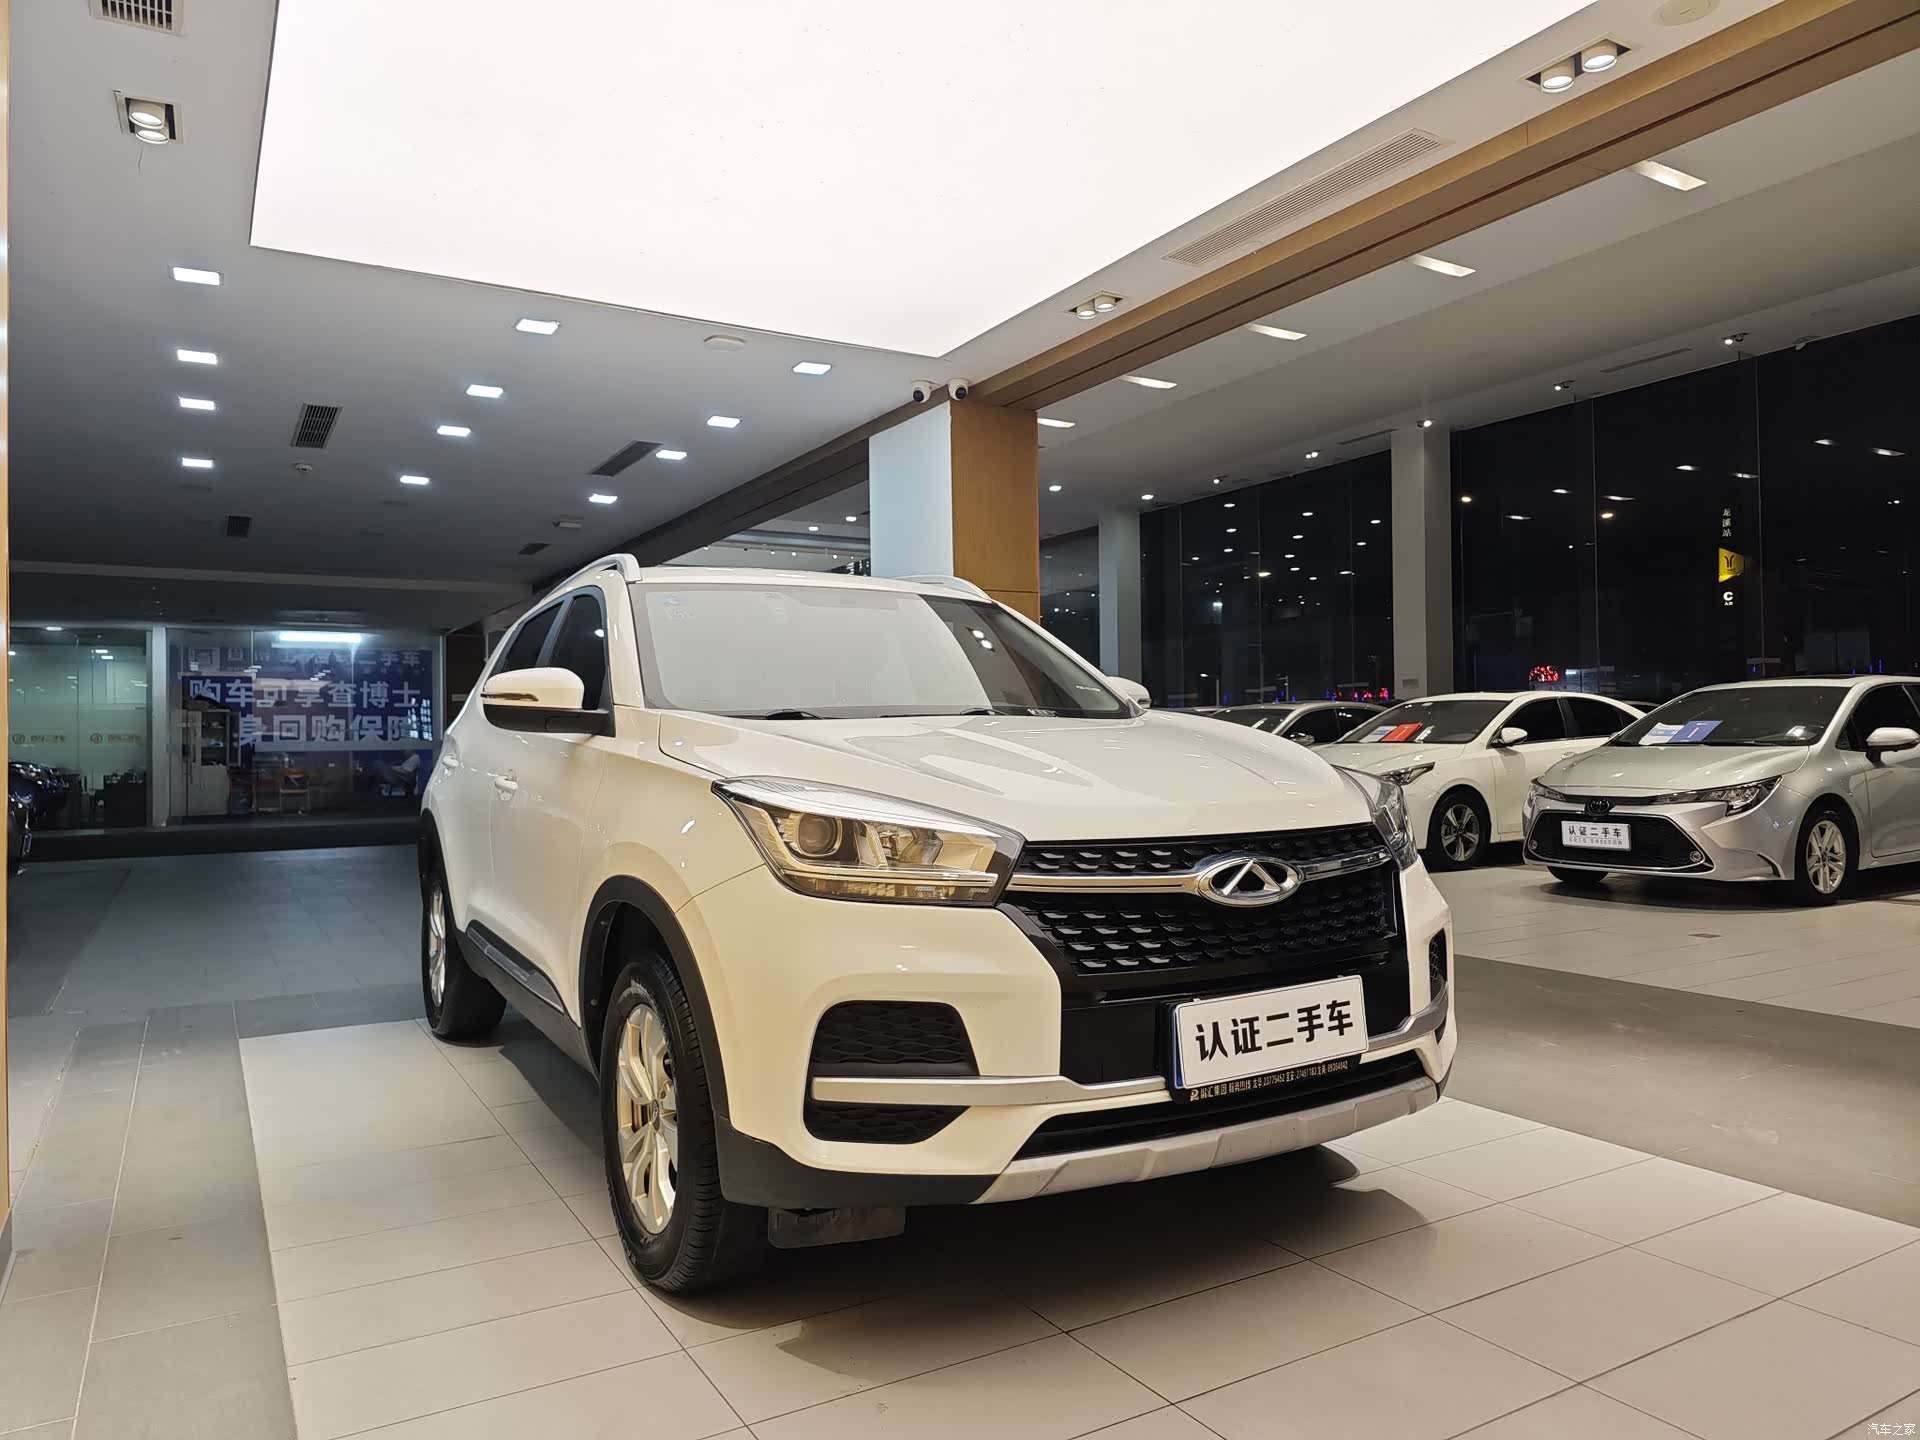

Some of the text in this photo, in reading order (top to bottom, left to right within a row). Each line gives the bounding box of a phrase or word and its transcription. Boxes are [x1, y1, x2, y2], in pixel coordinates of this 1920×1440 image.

[1722, 508, 1732, 537] 龙溪站
[1723, 591, 1733, 601] C
[1569, 826, 1622, 838] 认证二手车
[1195, 1000, 1353, 1061] 认证二手车
